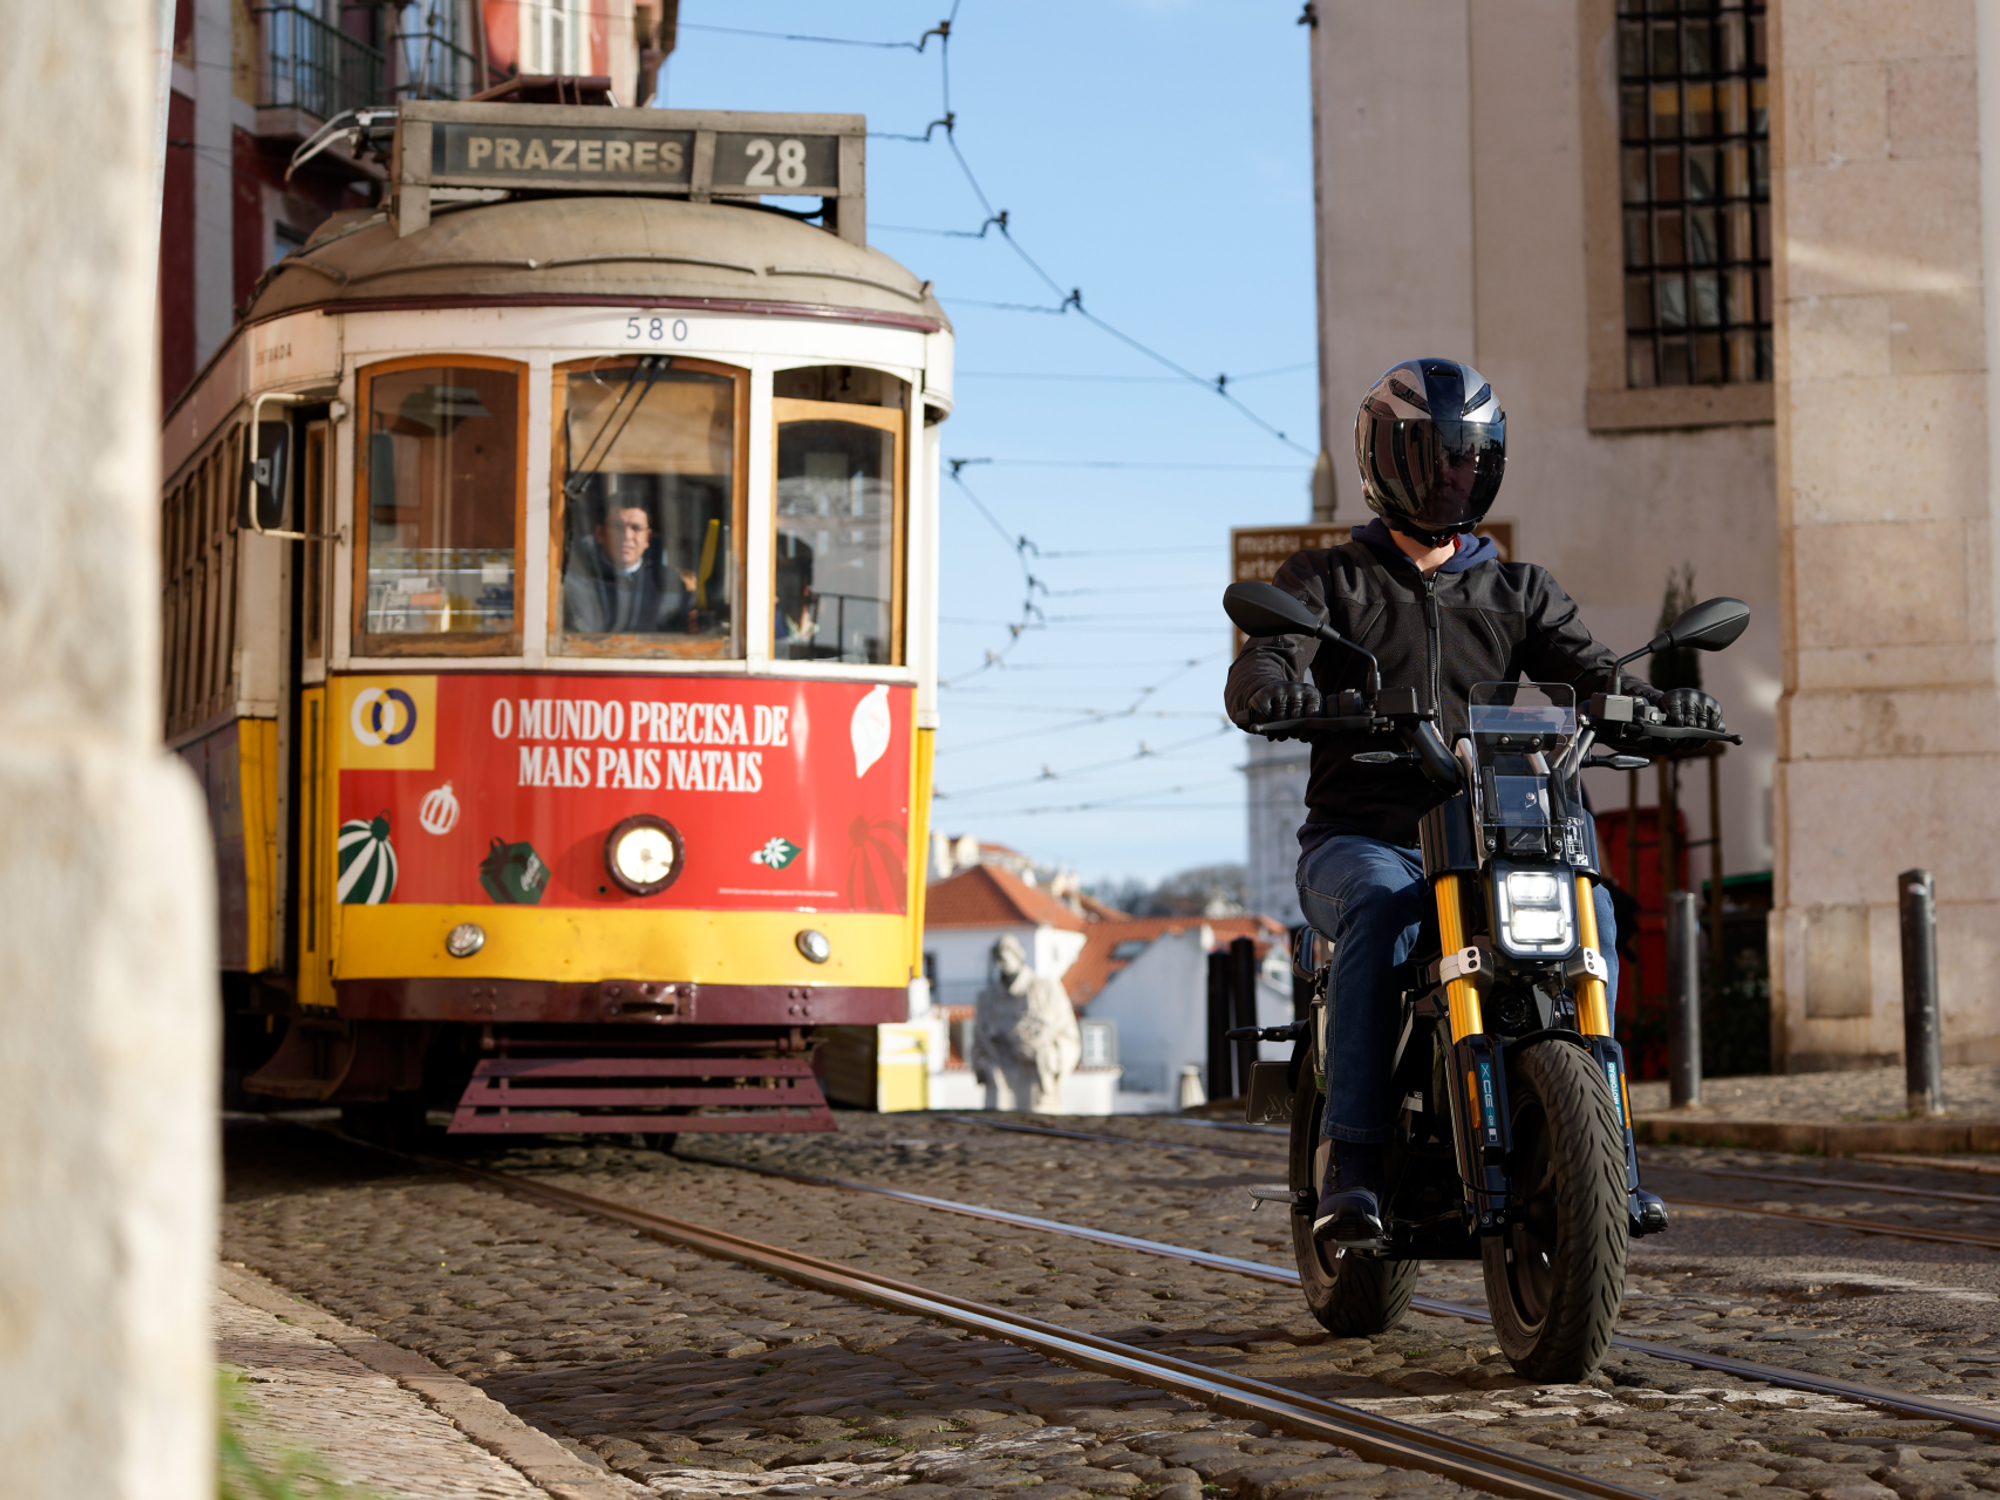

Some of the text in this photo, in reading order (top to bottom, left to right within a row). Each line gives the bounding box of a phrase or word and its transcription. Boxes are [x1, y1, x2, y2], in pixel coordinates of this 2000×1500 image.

[468, 136, 808, 188] PRAZERES 28
[626, 317, 688, 342] 580
[1238, 534, 1300, 554] museu
[1238, 557, 1284, 580] arte
[492, 698, 789, 747] O MUNDO PRECISA DE
[518, 746, 762, 793] MAIS PAIS NATAIS
[1608, 1062, 1620, 1105] MOTORRAD
